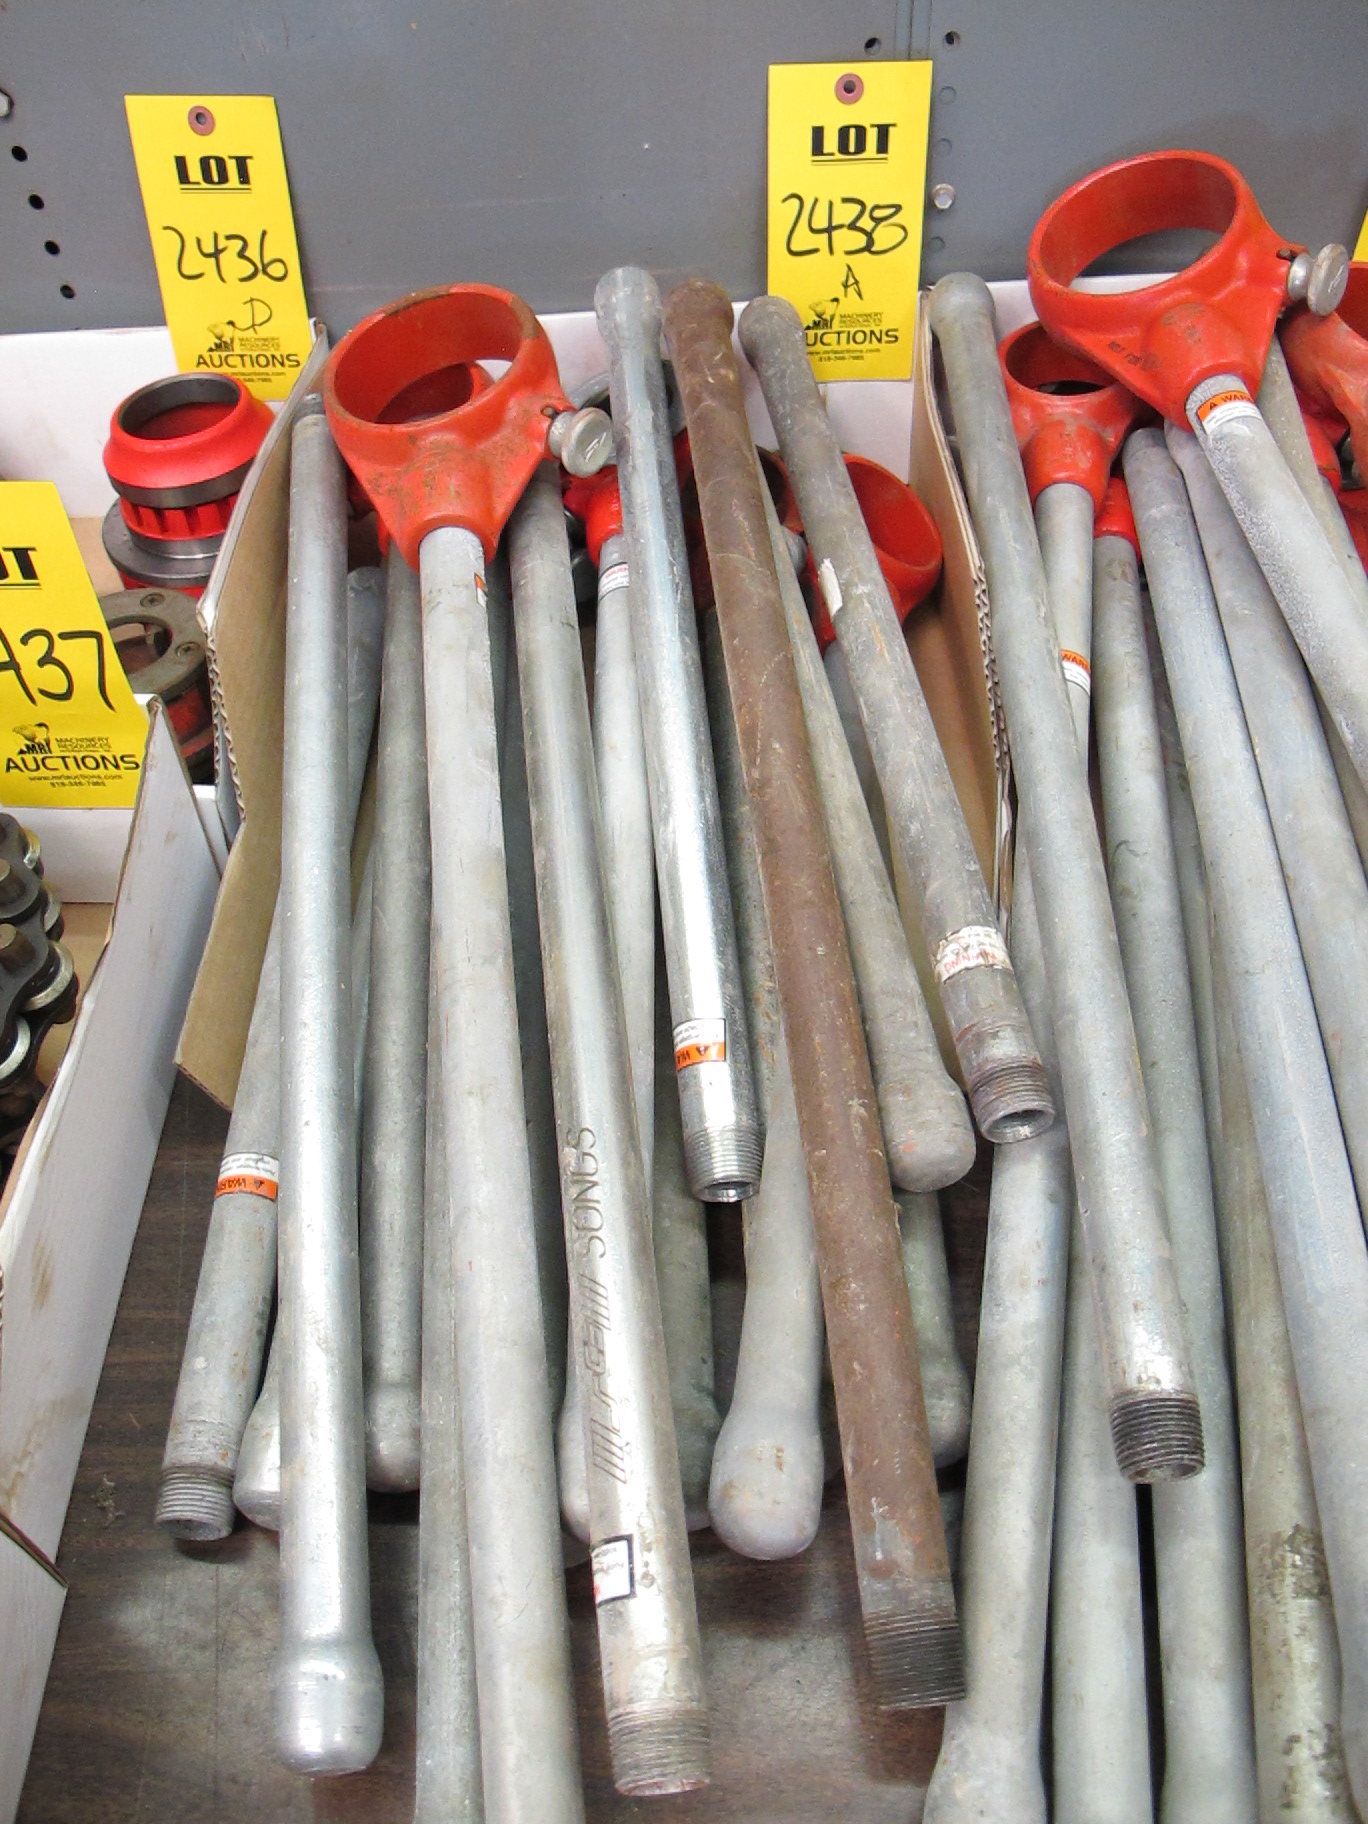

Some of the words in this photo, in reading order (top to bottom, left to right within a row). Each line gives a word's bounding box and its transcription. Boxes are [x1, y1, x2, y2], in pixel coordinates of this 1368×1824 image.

[811, 123, 897, 157] LOT
[174, 155, 254, 186] LOT
[781, 192, 909, 257] 2438
[163, 226, 288, 284] 2436
[841, 264, 864, 301] A
[806, 328, 899, 347] UCTIONS
[195, 353, 301, 369] AUCTIONS
[0, 627, 117, 712] 437
[5, 754, 140, 773] AUCTIONS
[565, 1126, 608, 1260] SONGS
